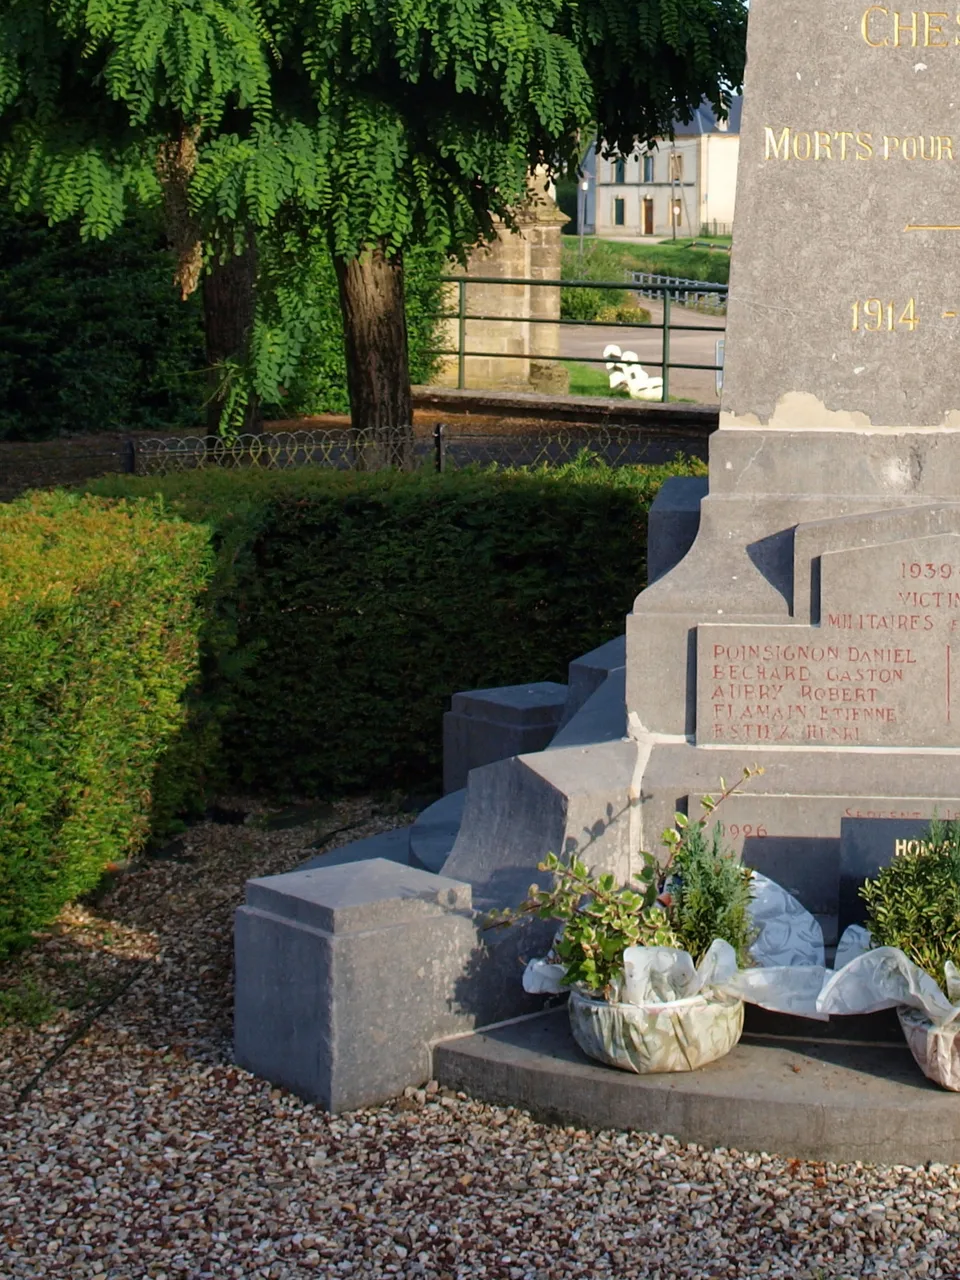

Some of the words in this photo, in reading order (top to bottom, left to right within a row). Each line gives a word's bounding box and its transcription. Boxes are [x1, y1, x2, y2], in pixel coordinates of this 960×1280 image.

[764, 126, 873, 161] MORTS
[883, 135, 953, 161] POUR
[851, 297, 920, 331] 1914
[828, 614, 934, 632] MILITAIRES
[713, 644, 839, 661] POINSIGNON
[848, 647, 917, 664] DANIEL
[827, 668, 904, 683] GASTON
[711, 684, 784, 701] AUBRY
[801, 685, 878, 702] ROBERT
